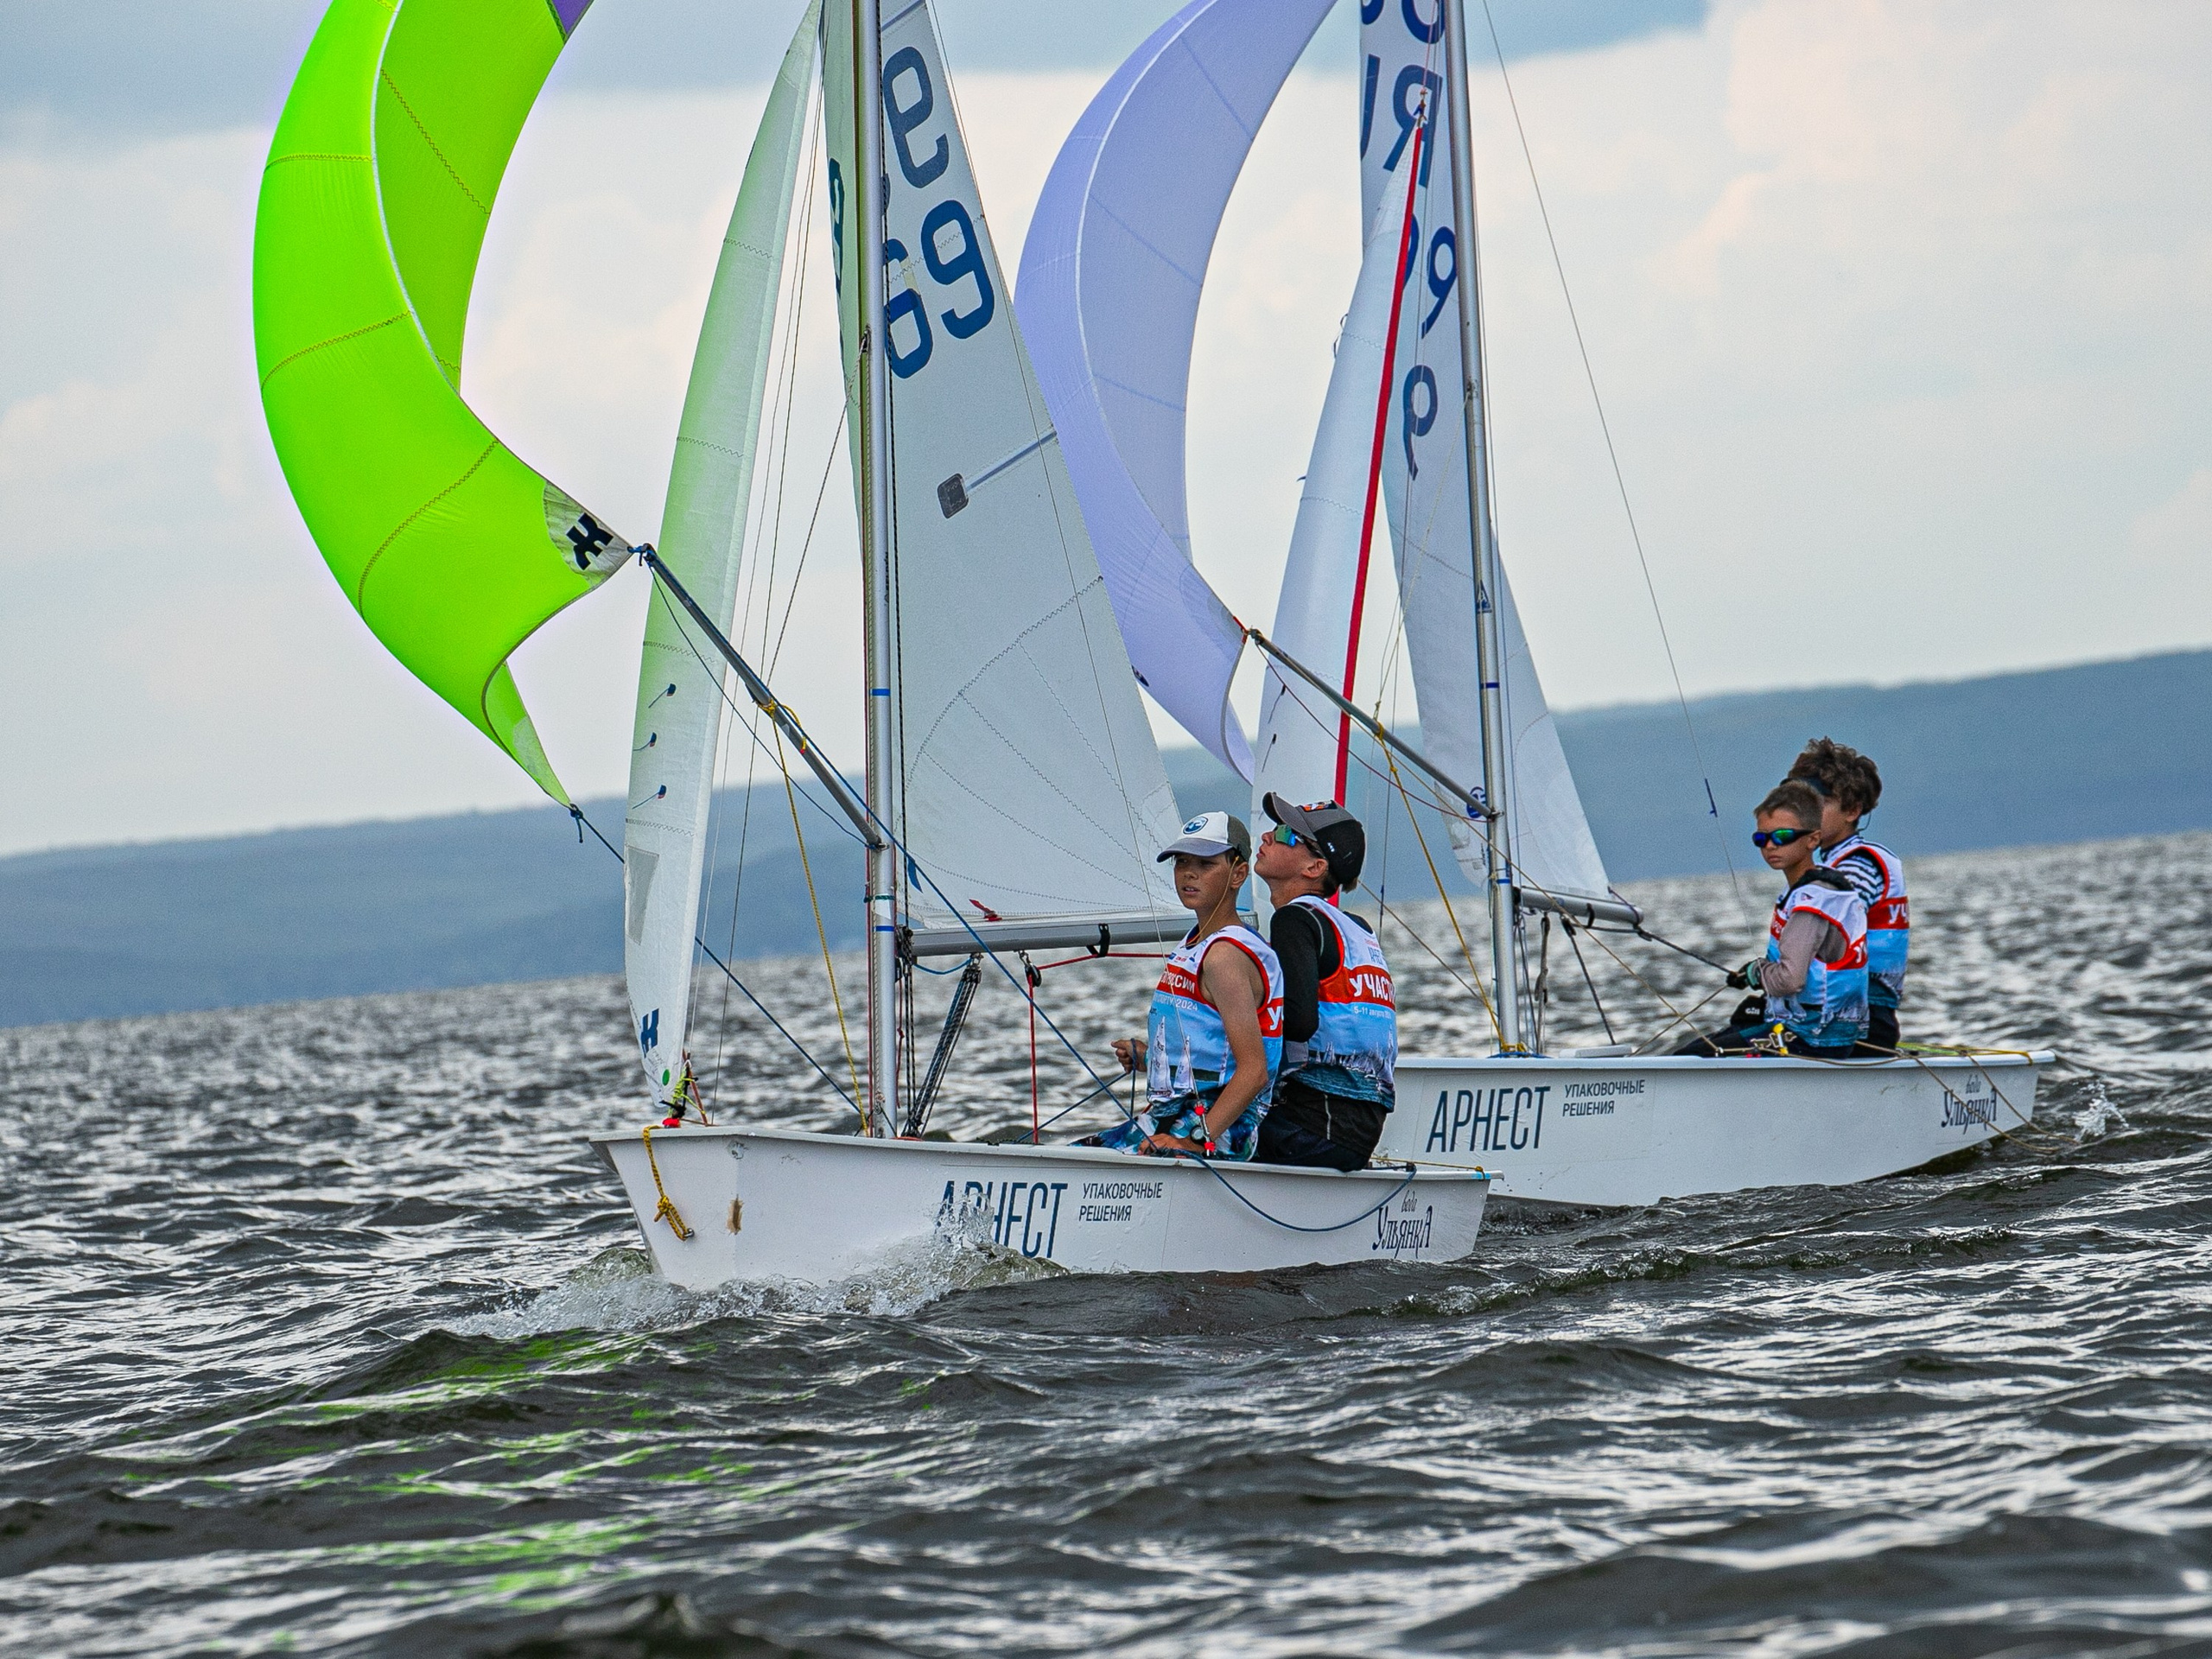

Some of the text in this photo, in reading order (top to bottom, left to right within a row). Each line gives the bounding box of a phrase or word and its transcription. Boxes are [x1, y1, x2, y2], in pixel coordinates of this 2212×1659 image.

[1176, 998, 1198, 1012] 2024
[1353, 1005, 1369, 1015] 5-11
[1426, 1079, 1646, 1153] АРНЕСТ УПАКОВОЧНЫЕ
[1562, 1100, 1615, 1117] РЕШЕНИЯ
[1083, 1182, 1163, 1200] УПАКОВОЧНЫЕ
[1079, 1205, 1132, 1222] РЕШЕНИЯ
